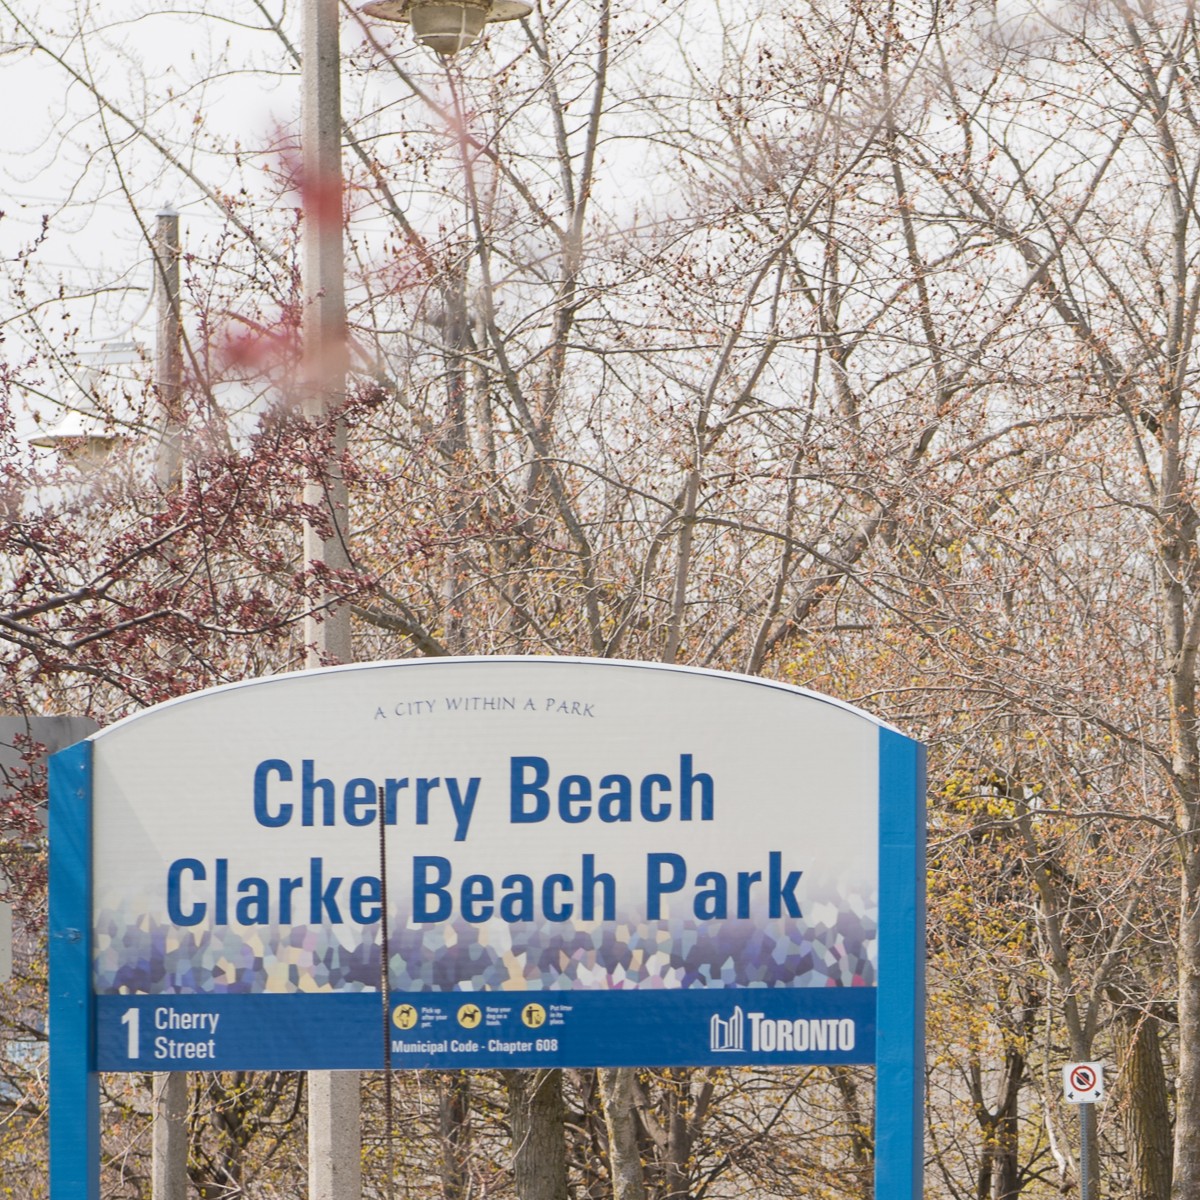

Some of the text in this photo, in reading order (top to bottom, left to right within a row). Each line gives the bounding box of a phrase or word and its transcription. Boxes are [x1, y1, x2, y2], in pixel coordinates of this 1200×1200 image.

[373, 696, 596, 720] A CITY WITHIN A PARK
[253, 754, 715, 842] Cherry Beach
[166, 850, 804, 927] Clarke Beach Park
[121, 1007, 220, 1060] 1 Cherry
[154, 1037, 216, 1060] Street
[391, 1040, 448, 1055] Municipal
[450, 1040, 479, 1053] Code
[487, 1039, 533, 1054] Chapter
[535, 1039, 559, 1052] 608
